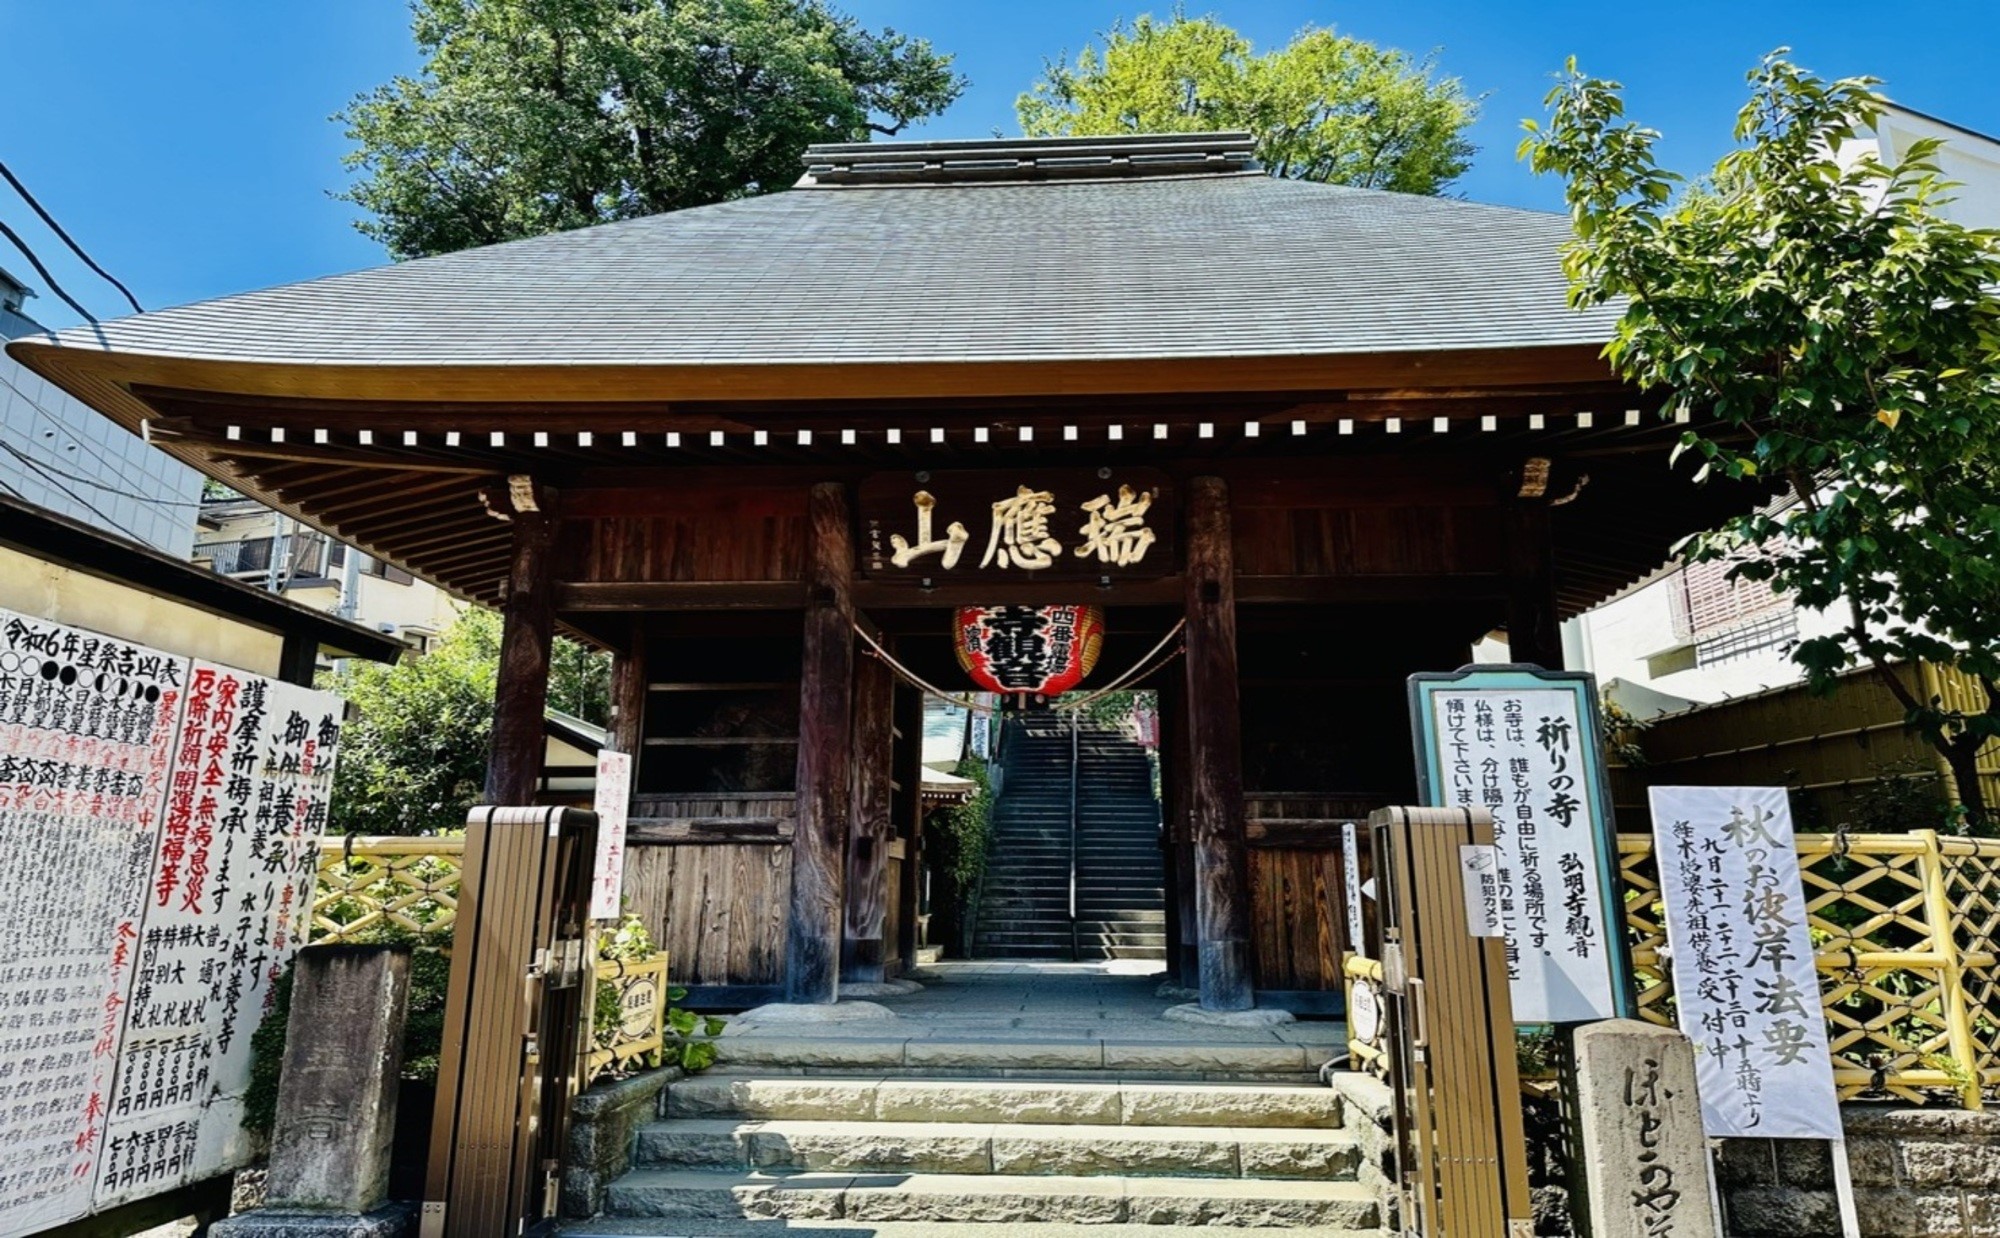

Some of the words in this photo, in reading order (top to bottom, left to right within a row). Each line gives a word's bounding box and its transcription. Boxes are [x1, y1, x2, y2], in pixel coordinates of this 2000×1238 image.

[1535, 715, 1580, 828] 祈りの寺
[1480, 873, 1499, 928] 防犯カメラ
[1721, 804, 1816, 1067] 秋のお彼岸法要
